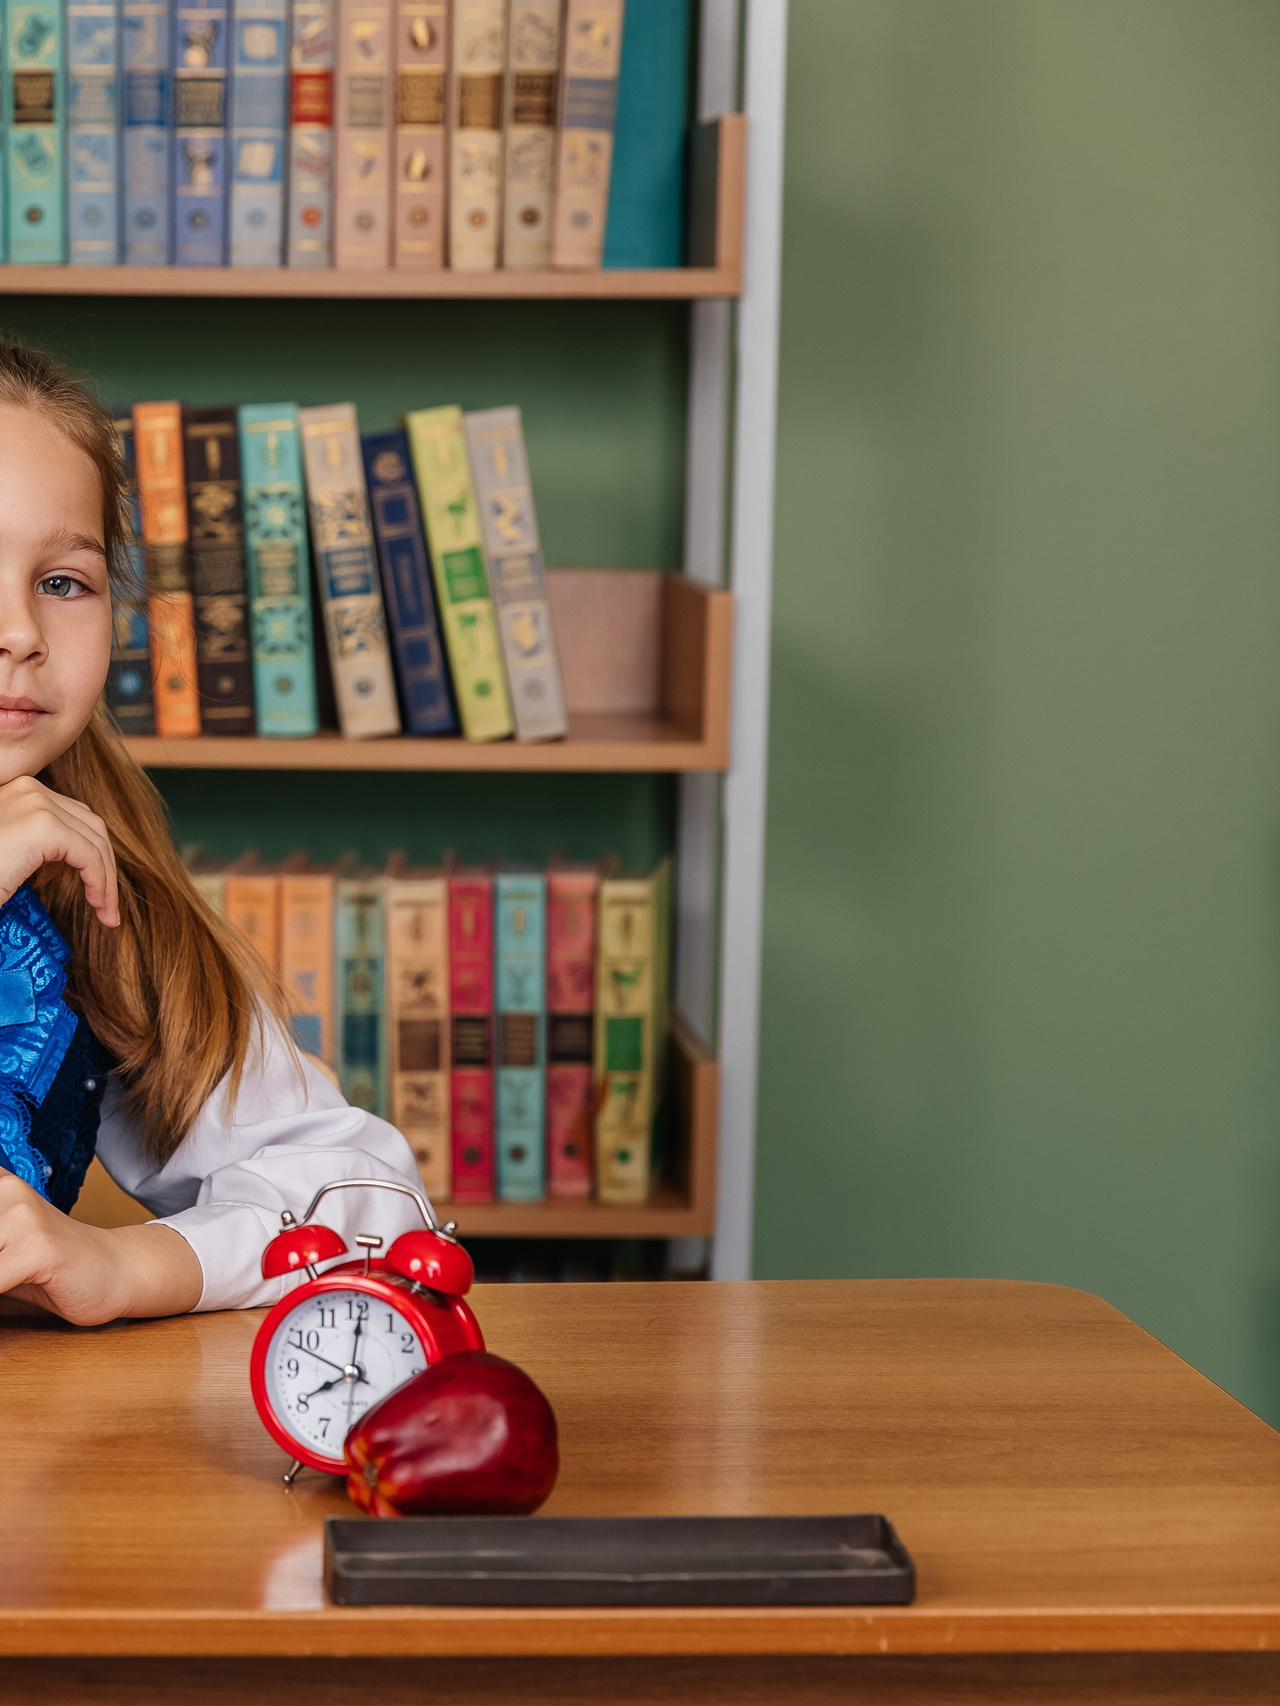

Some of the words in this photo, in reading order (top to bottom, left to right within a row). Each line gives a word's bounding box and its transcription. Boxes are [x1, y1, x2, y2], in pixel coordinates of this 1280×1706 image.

[317, 1308, 338, 1329] 11
[345, 1300, 370, 1321] 12
[386, 1313, 396, 1334] 1
[297, 1330, 320, 1352] 10
[401, 1333, 416, 1354] 2
[287, 1359, 299, 1380] 9
[296, 1393, 310, 1414] 8
[318, 1417, 332, 1438] 7
